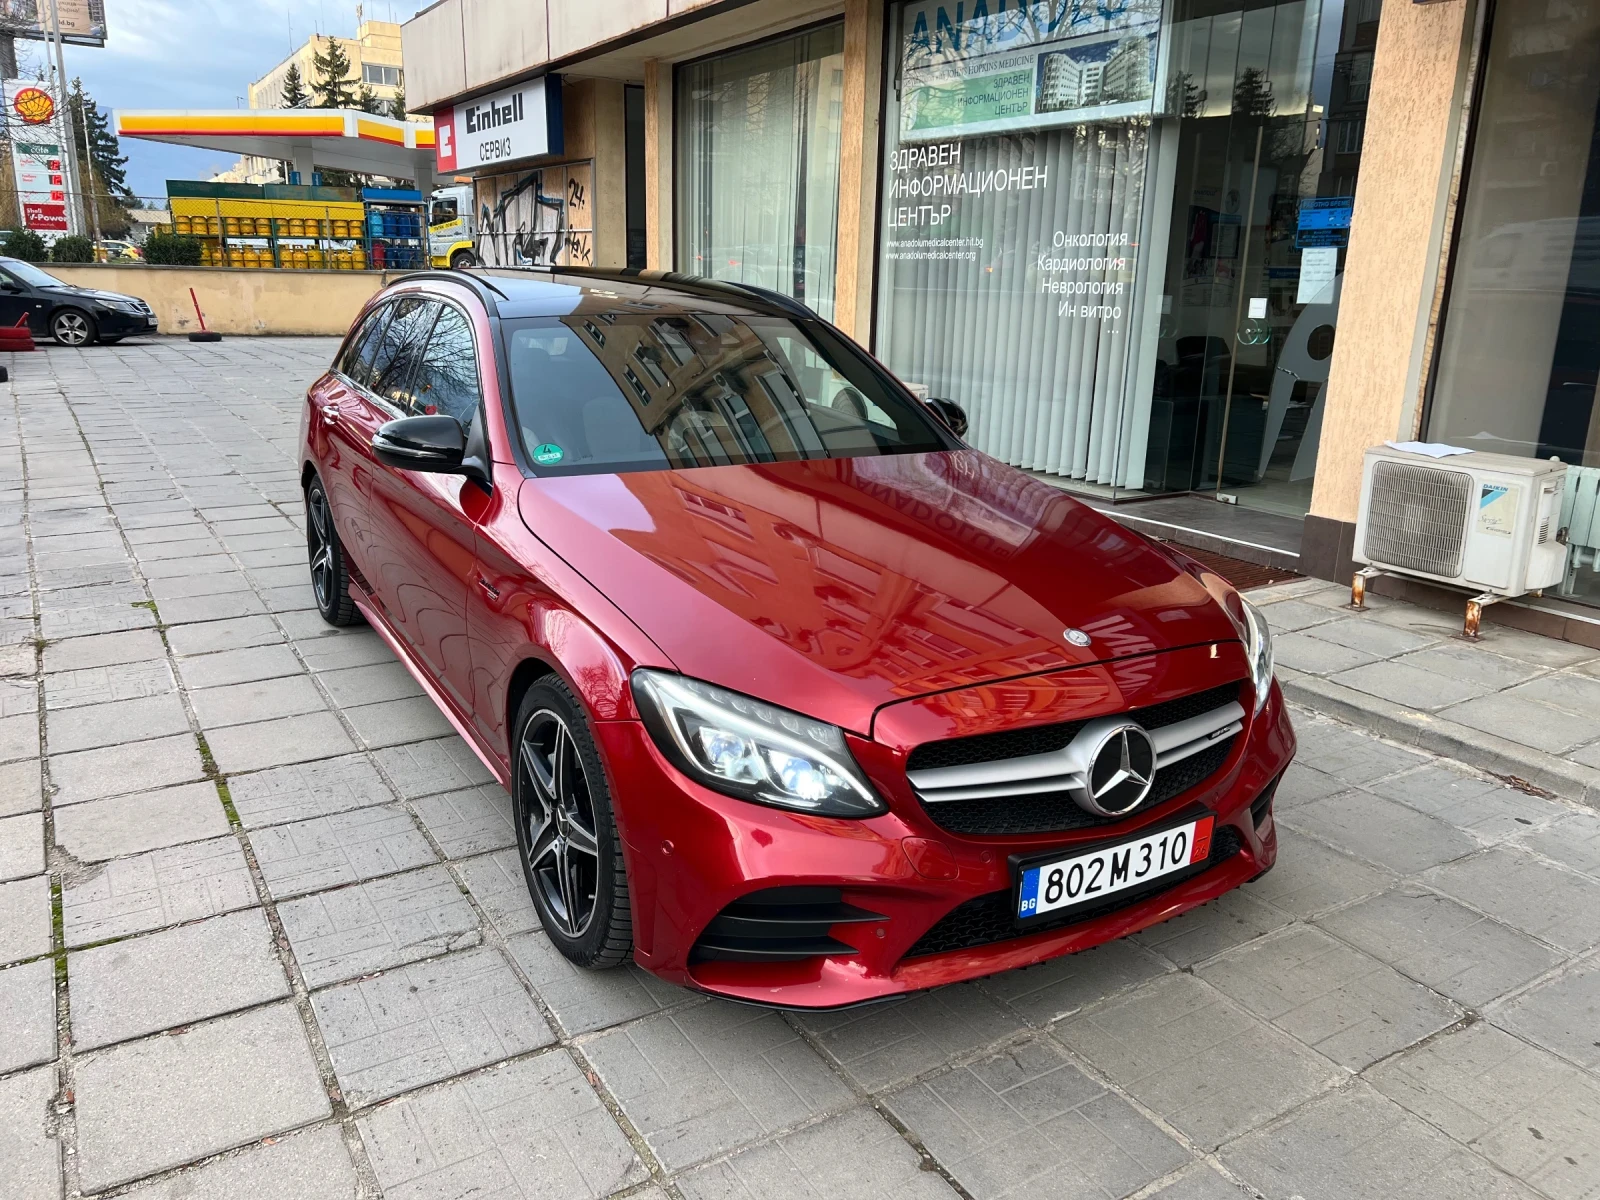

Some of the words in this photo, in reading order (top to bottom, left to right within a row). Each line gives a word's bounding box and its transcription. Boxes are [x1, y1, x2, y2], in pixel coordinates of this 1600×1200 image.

[968, 62, 997, 75] HOPKINS
[999, 55, 1035, 69] MEDICINE
[993, 73, 1030, 89] ЗДРАВЕН
[957, 88, 1029, 107] ИНФОРМАЦИОНЕН
[466, 93, 524, 134] Einhell
[994, 102, 1028, 116] ЦЕНТЪР
[479, 136, 512, 162] СЕРВИЗ
[889, 142, 962, 174] ЗДРАВЕН
[888, 165, 1049, 200] ИНФОРМАЦИОНЕН
[887, 204, 952, 232] ЦЕНТЪР
[1053, 230, 1128, 248] Онкология
[885, 250, 976, 262] www.anadolumedicalcenter.org
[1037, 254, 1126, 275] Кардиология
[1041, 277, 1124, 298] Неврология
[1058, 300, 1077, 318] Ин
[1080, 305, 1122, 323] витро
[1483, 484, 1508, 492] DAIKIN
[1020, 898, 1036, 912] BG
